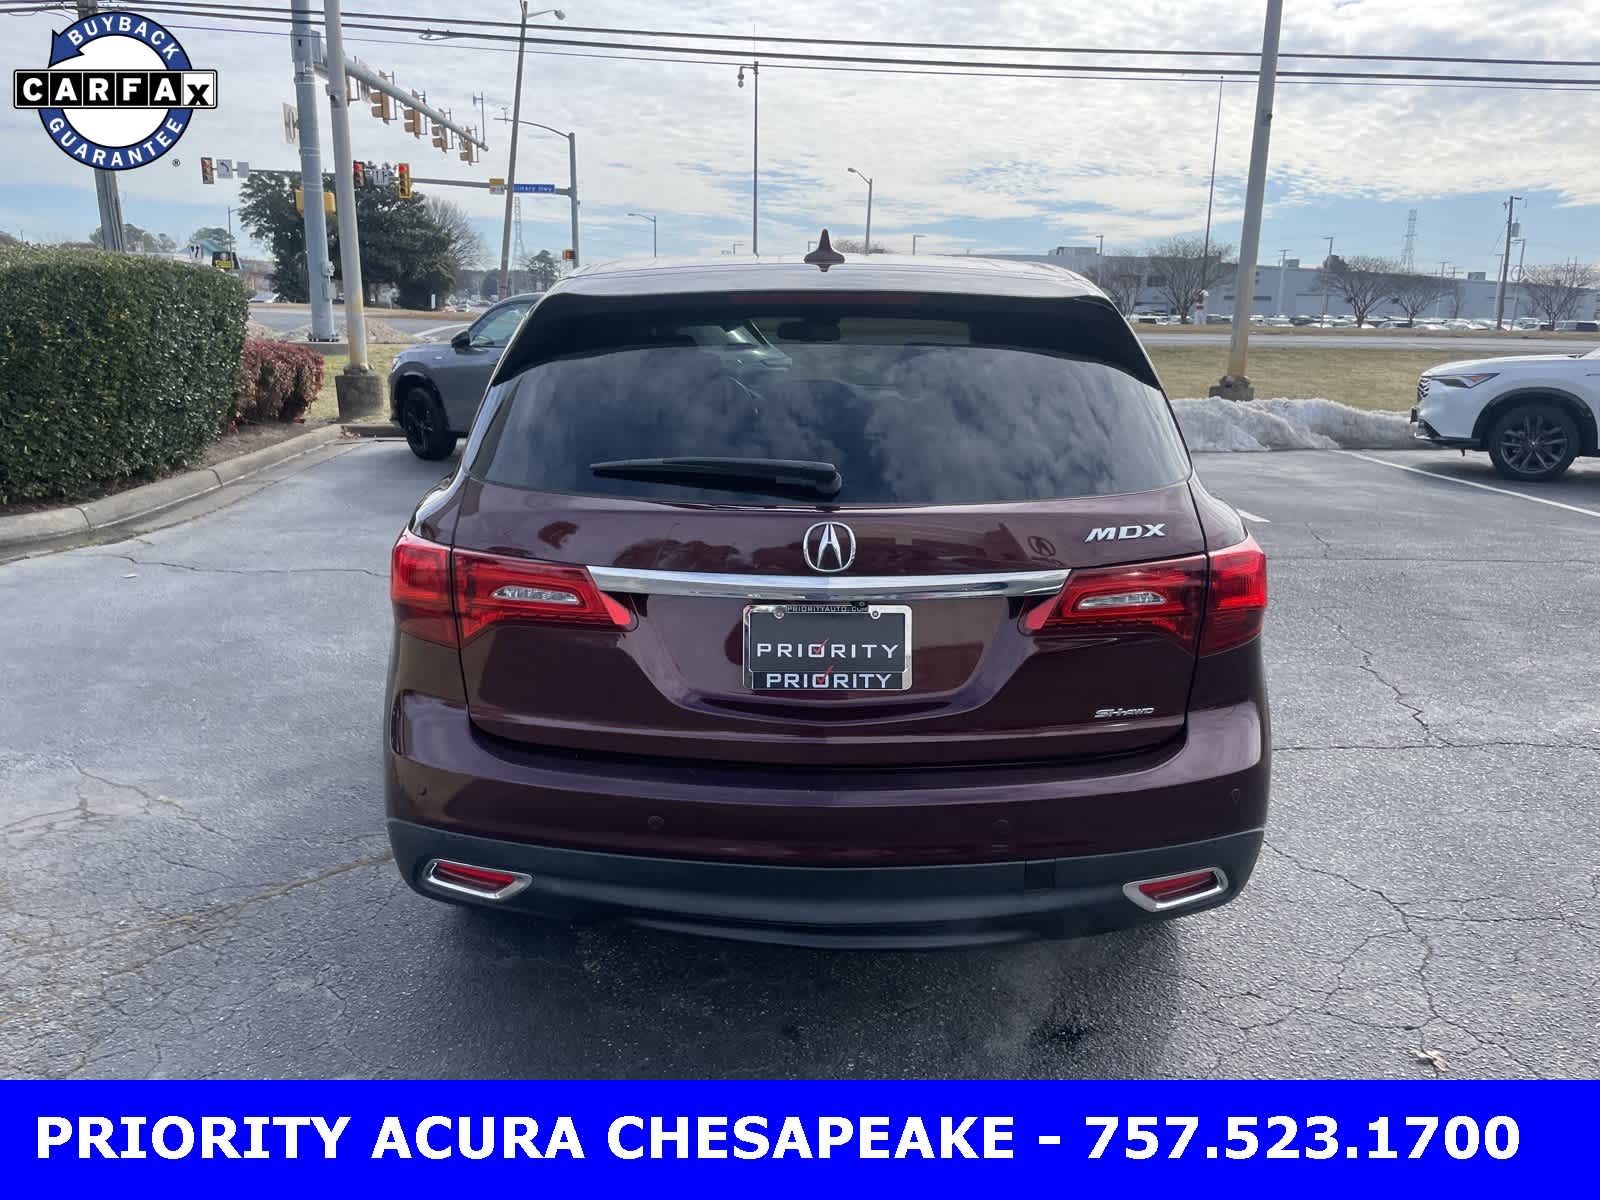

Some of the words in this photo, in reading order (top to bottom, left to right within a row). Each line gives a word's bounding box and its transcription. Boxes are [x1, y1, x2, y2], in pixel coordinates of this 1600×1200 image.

[1085, 523, 1166, 543] MDX
[757, 643, 898, 659] PRIORITY
[766, 673, 892, 689] PRIORITY
